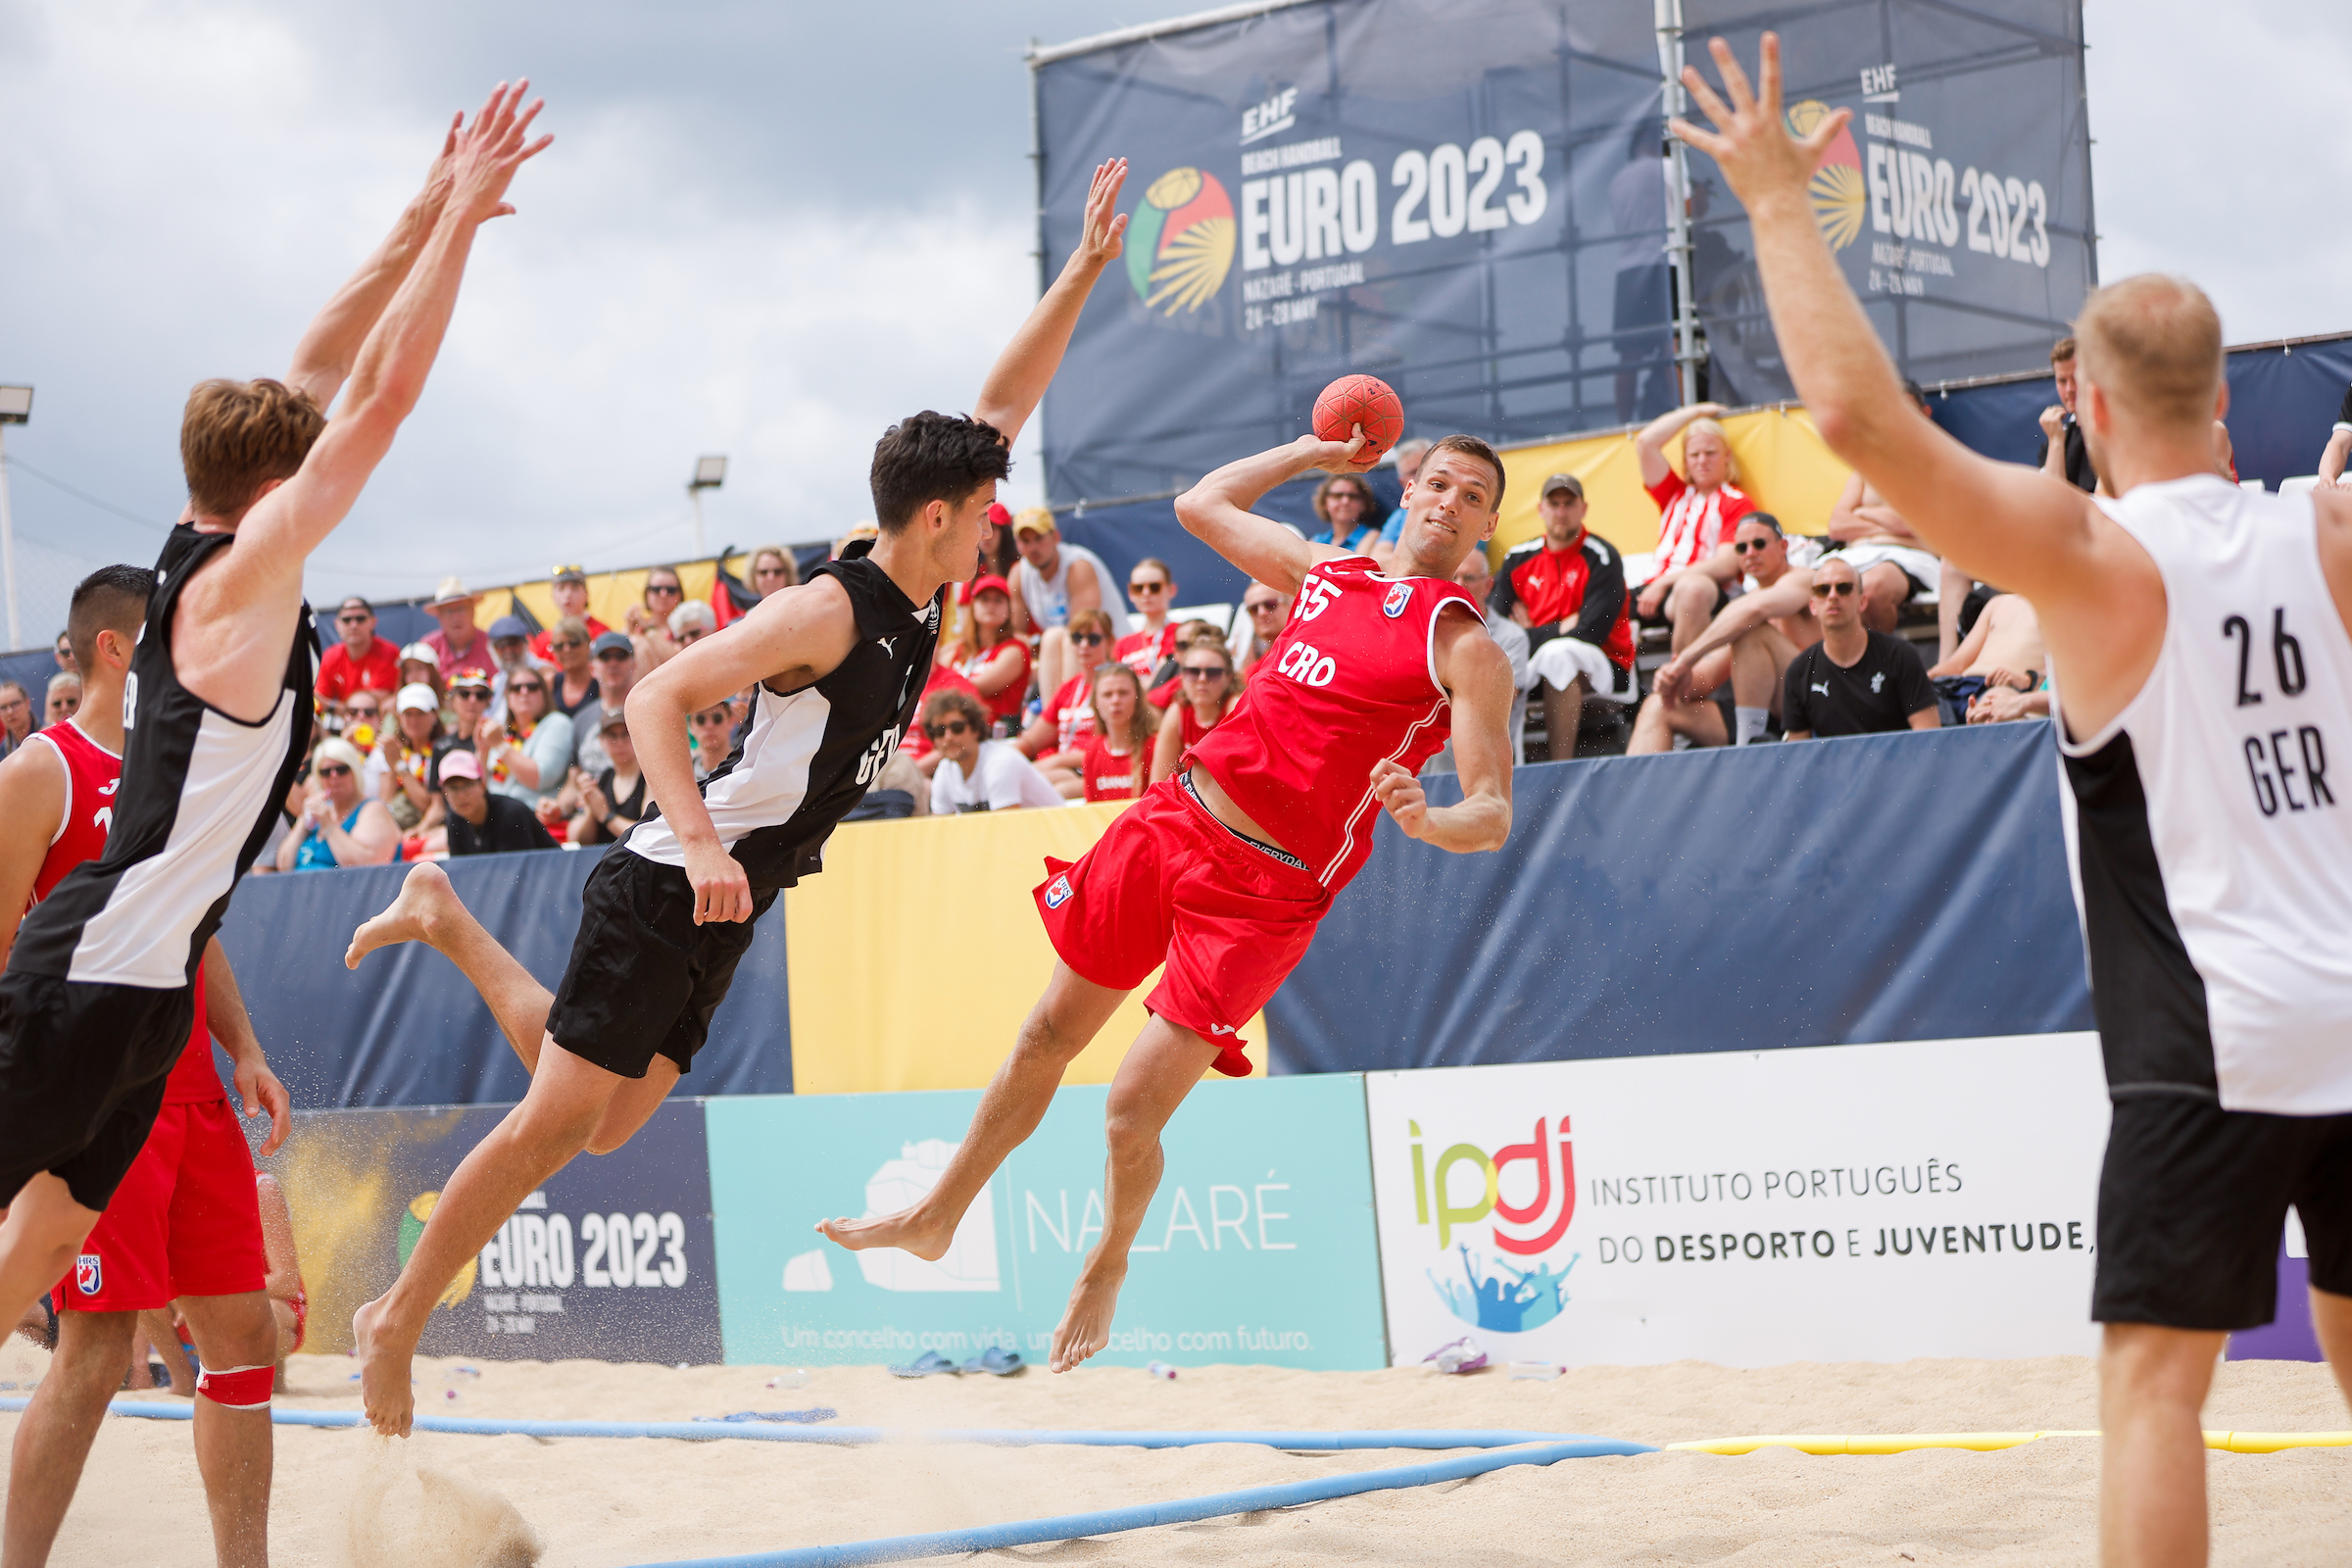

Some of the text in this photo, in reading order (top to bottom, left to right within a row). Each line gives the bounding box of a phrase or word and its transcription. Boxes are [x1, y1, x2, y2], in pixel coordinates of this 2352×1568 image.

[1860, 63, 1896, 95] EHF
[1241, 86, 1298, 137] EHF
[1242, 129, 1548, 271] EURO 2023
[1867, 142, 2050, 269] EURO 2023
[1299, 261, 1366, 293] PORTUGAL
[1294, 573, 1344, 621] 55
[1277, 641, 1337, 687] CRO
[2223, 608, 2306, 708] 26
[2244, 725, 2335, 816] GER
[1408, 1115, 1576, 1255] ipdj
[1592, 1157, 1962, 1206] INSTITUTO PORTUGUÊS
[1025, 1169, 1297, 1253] NAARÉ
[78, 1256, 99, 1265] HRS
[479, 1211, 688, 1288] EURO 2023
[1599, 1221, 2094, 1264] DO DESPORTO E JUVENTUDE,
[782, 1326, 820, 1348] Um
[823, 1327, 915, 1350] concelho
[919, 1331, 967, 1350] com
[1107, 1326, 1172, 1351] celho
[1177, 1332, 1230, 1352] com
[1237, 1325, 1313, 1351] futuro.
